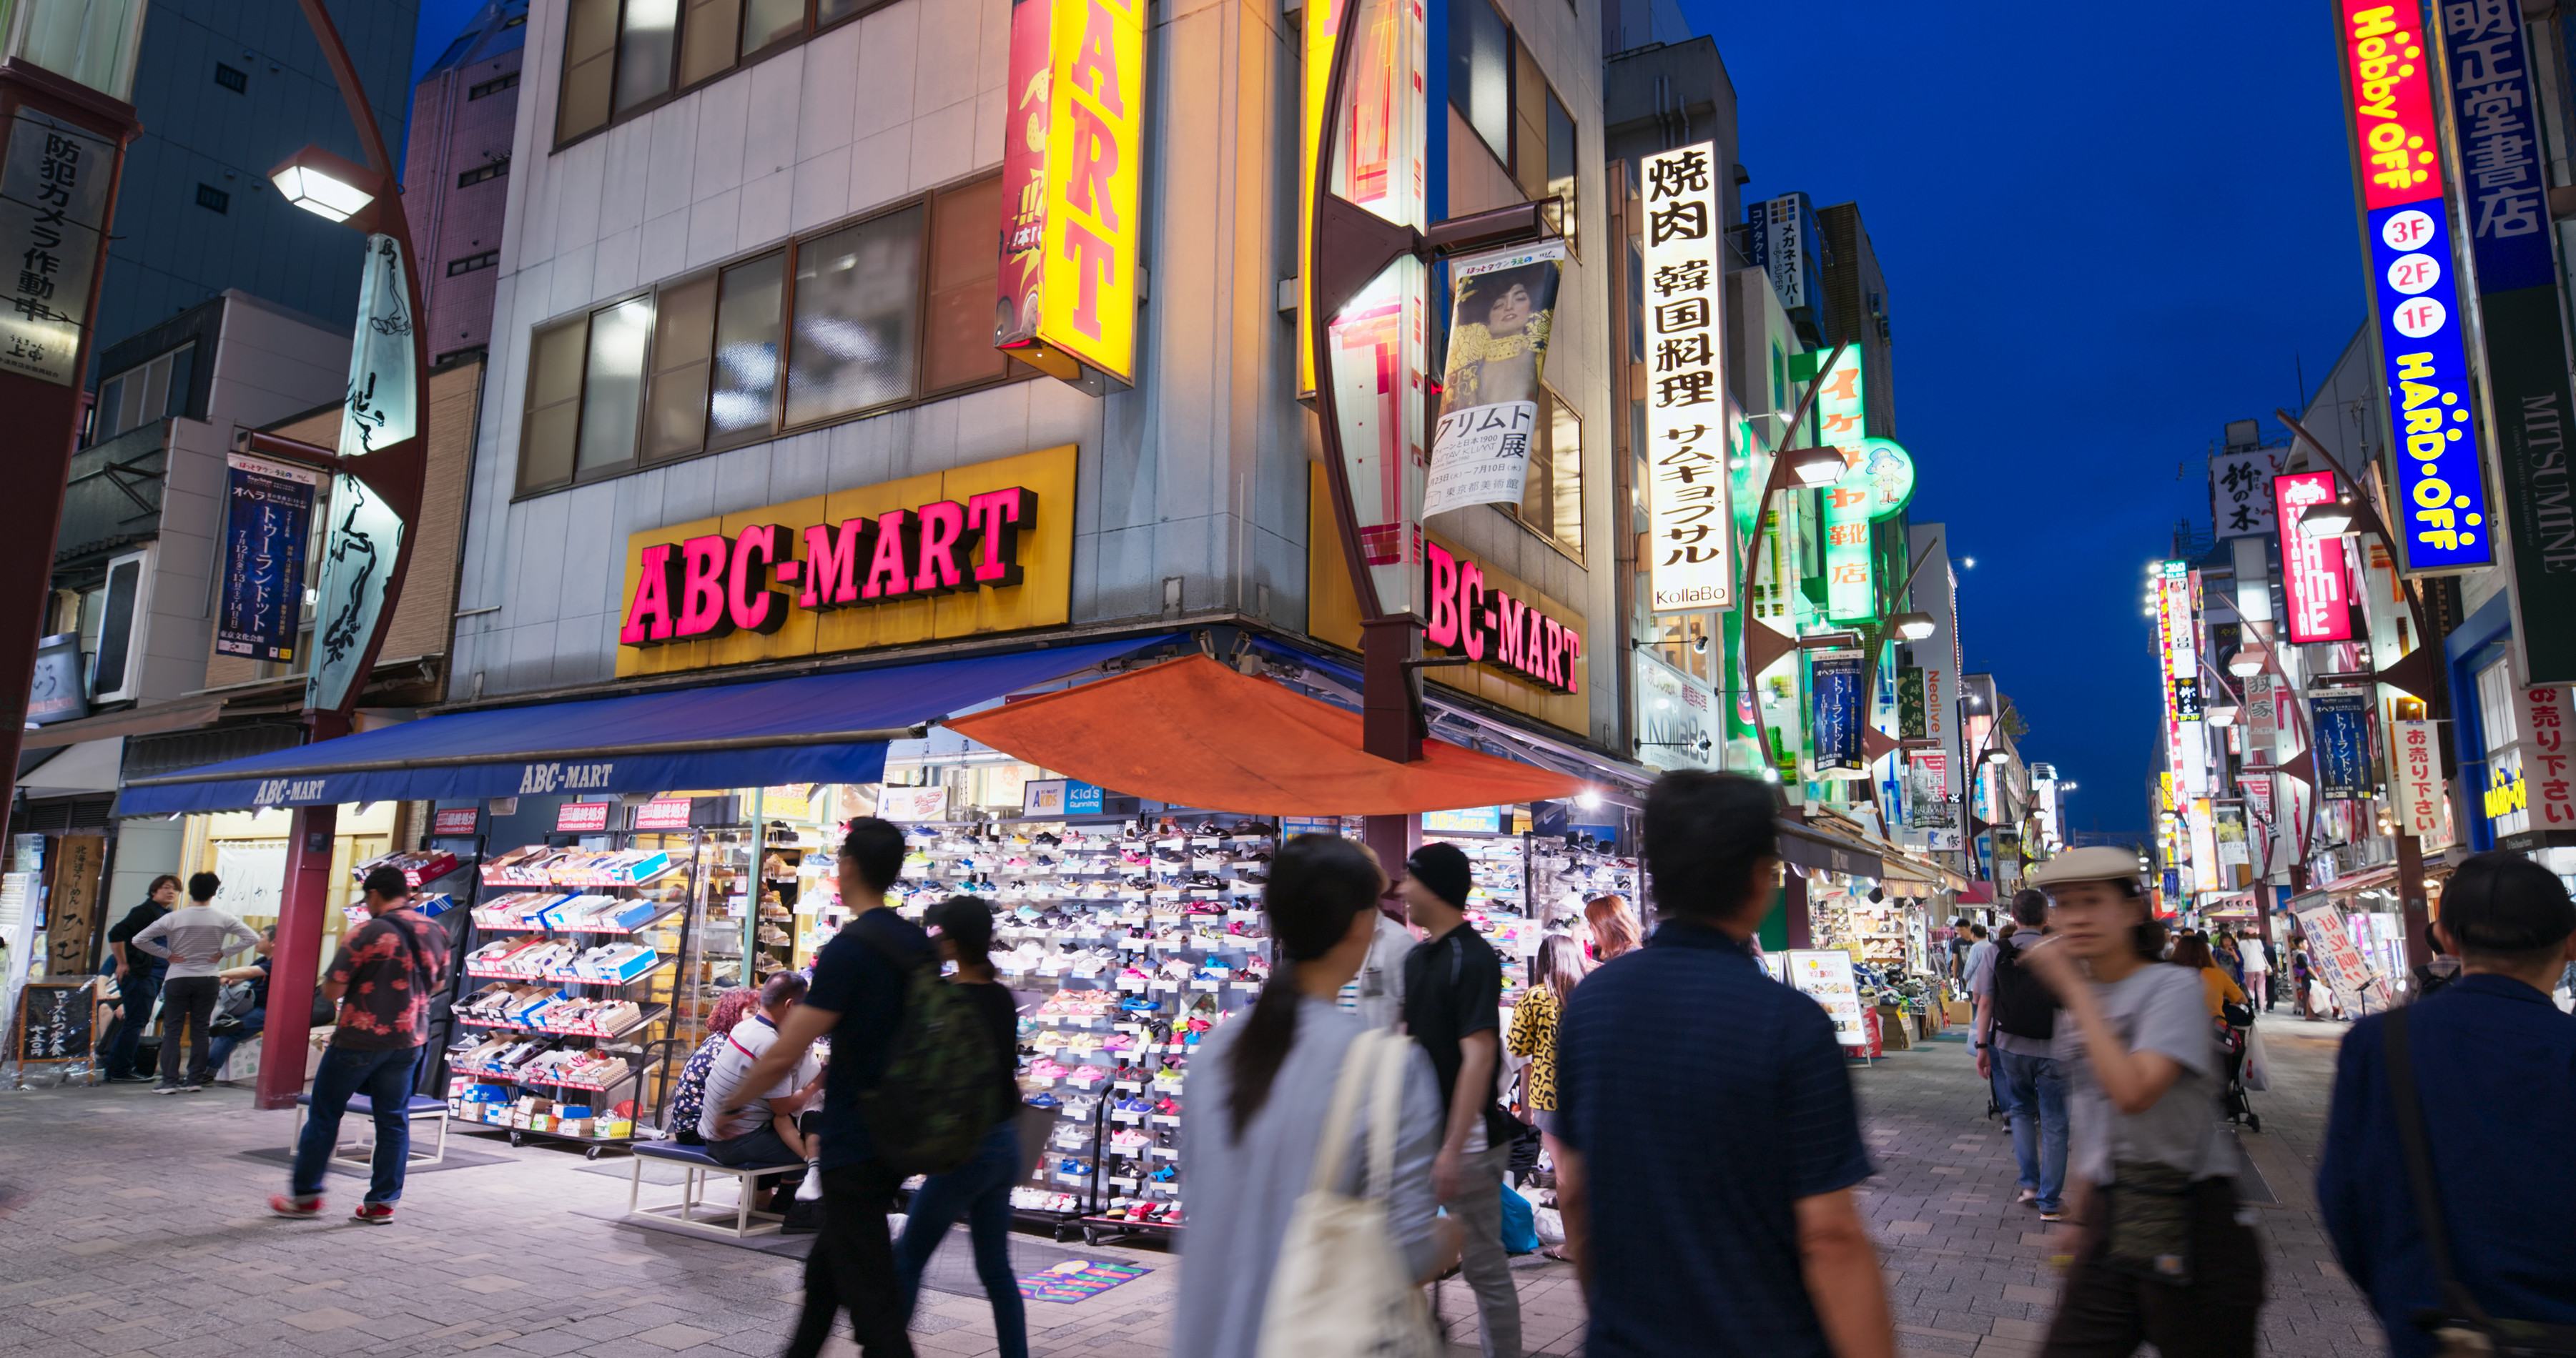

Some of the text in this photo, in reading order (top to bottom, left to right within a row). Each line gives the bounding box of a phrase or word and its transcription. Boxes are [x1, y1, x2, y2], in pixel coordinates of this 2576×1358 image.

[2353, 6, 2412, 189] Hobby OFF
[2444, 0, 2540, 238] 明正堂書店
[1063, 0, 1132, 343] ART
[14, 132, 82, 322] 防犯カメラ作動中
[1752, 209, 1765, 264] コンタクト
[2392, 218, 2425, 243] 3F
[1466, 256, 1533, 274] ほっとタウンうえの
[1782, 223, 1798, 305] メガネスーパー
[2397, 261, 2430, 287] 2F
[2402, 305, 2433, 329] 1F
[1649, 150, 1720, 567] 焼肉 韓国料理 サムギョプサル
[1433, 405, 1530, 459] クリムト 展
[239, 462, 292, 479] ほっとタウンうえの
[1445, 477, 1520, 499] 東京都美術館
[2220, 461, 2260, 532] 鉢の木
[620, 486, 1024, 646] ABC-MART
[2298, 507, 2339, 636] AME
[1423, 540, 1579, 695] BC-MART
[1655, 585, 1726, 605] KollaBo
[219, 630, 265, 643] 東京文化会館
[1682, 683, 1708, 713] 韓国料理
[1928, 670, 1942, 733] Neolive
[519, 763, 614, 795] ABC-MART
[1926, 756, 1945, 803] 三国志
[2406, 729, 2436, 831] お売り下さい
[2529, 688, 2575, 823] お売り下さい
[253, 780, 325, 805] ABC-MART
[571, 807, 606, 821] 最終処分
[652, 803, 691, 819] 最終処分
[1069, 800, 1100, 808] Running
[1070, 785, 1100, 799] Kid's
[448, 812, 476, 826] 最終処分
[1429, 812, 1487, 831] 10%OFF
[69, 845, 87, 906] 北海道らーめん
[56, 913, 84, 976] ひむ
[48, 990, 69, 1056] ロースかつ定食
